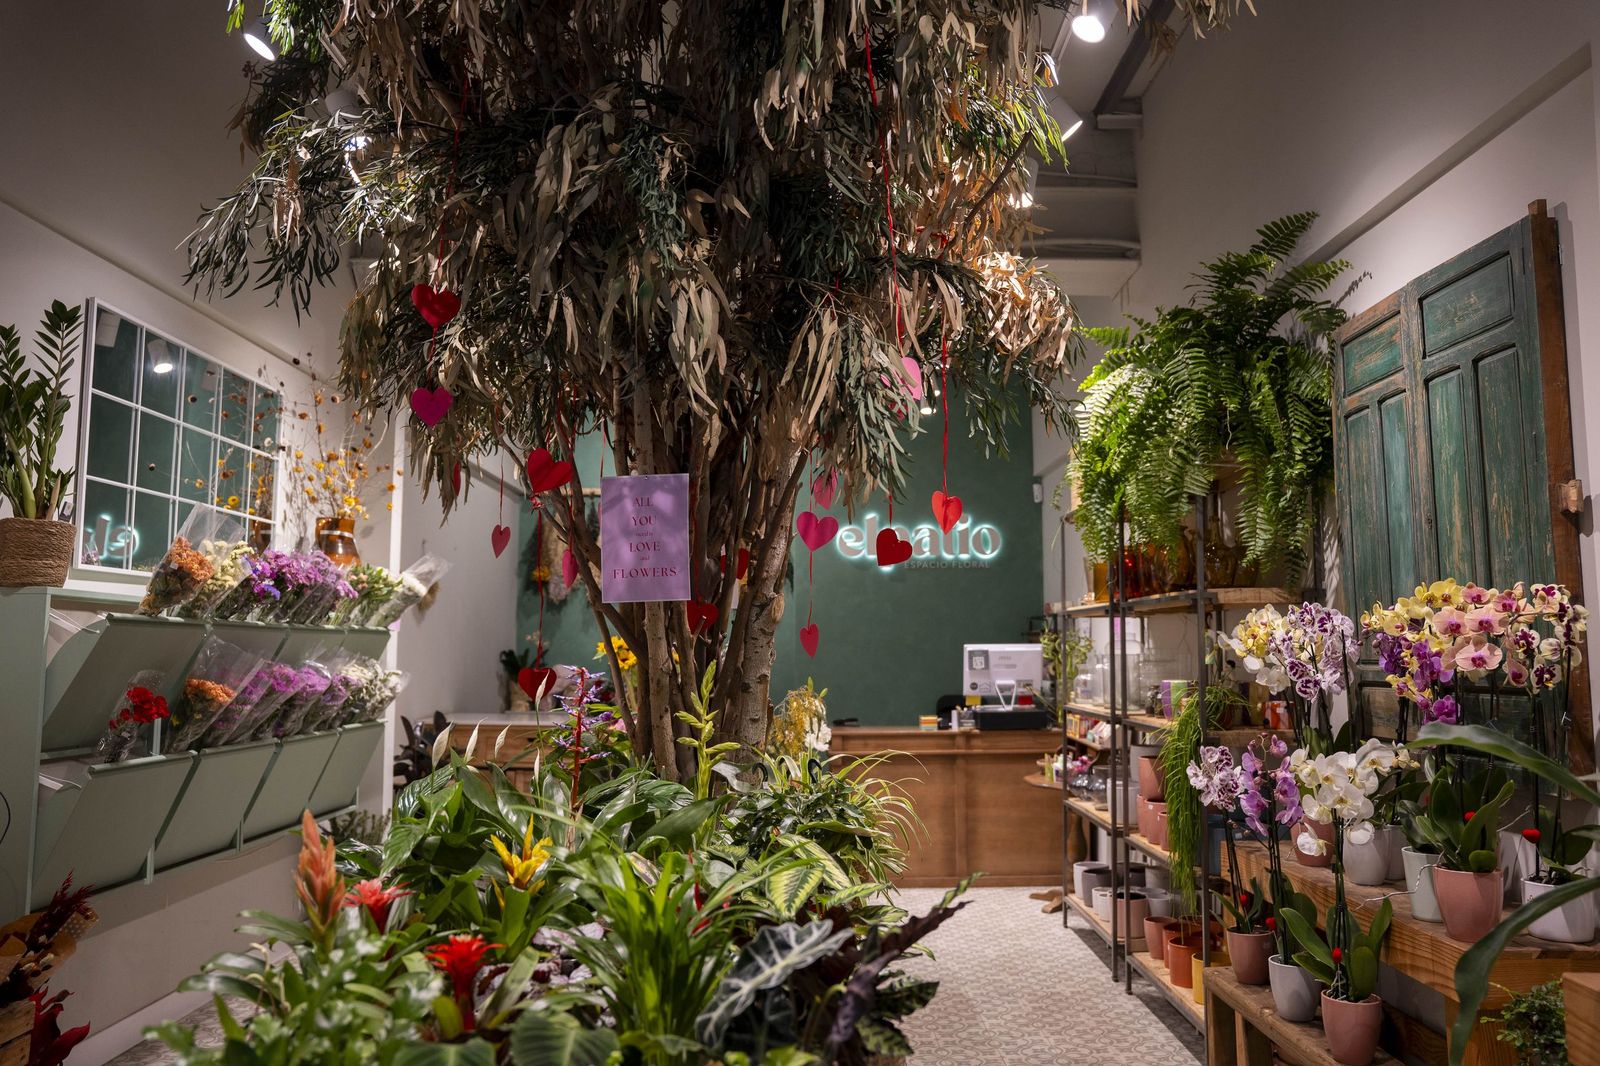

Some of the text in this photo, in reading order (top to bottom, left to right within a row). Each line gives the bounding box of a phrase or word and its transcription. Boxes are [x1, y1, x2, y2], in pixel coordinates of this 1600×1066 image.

[633, 497, 653, 507] ALL
[632, 516, 656, 526] YOU
[629, 541, 661, 552] LOVE
[904, 560, 992, 569] ESPACIO FLORAL
[613, 567, 677, 579] FLOWERS
